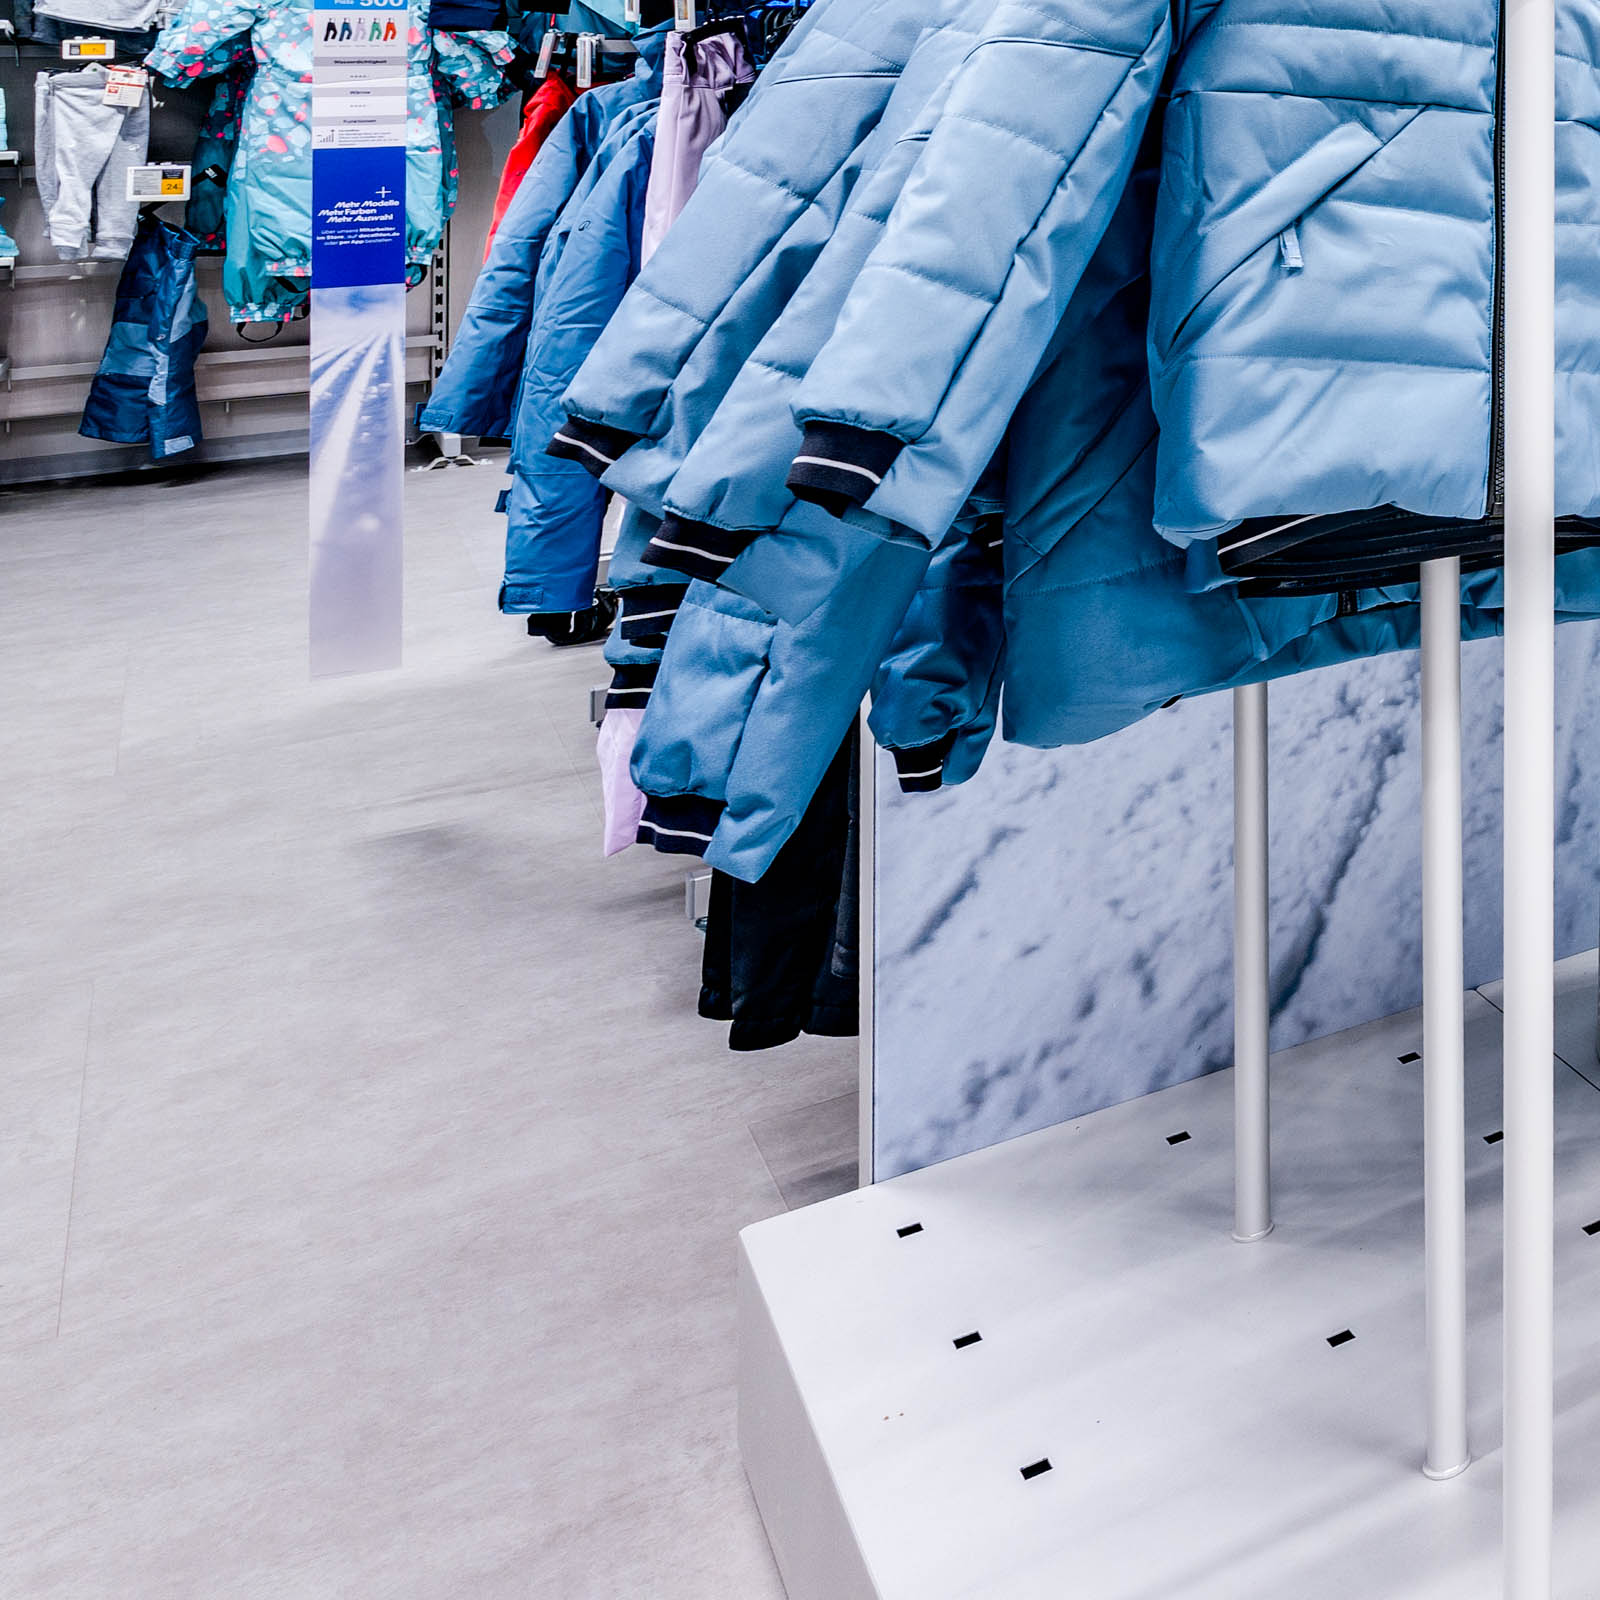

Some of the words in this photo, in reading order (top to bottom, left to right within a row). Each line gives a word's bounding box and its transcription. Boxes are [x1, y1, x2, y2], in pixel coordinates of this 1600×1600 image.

[335, 201, 360, 209] Mehr
[317, 209, 344, 217] Mehr
[344, 207, 377, 215] Farben
[326, 216, 352, 224] Mehr
[353, 214, 394, 222] Auswahl
